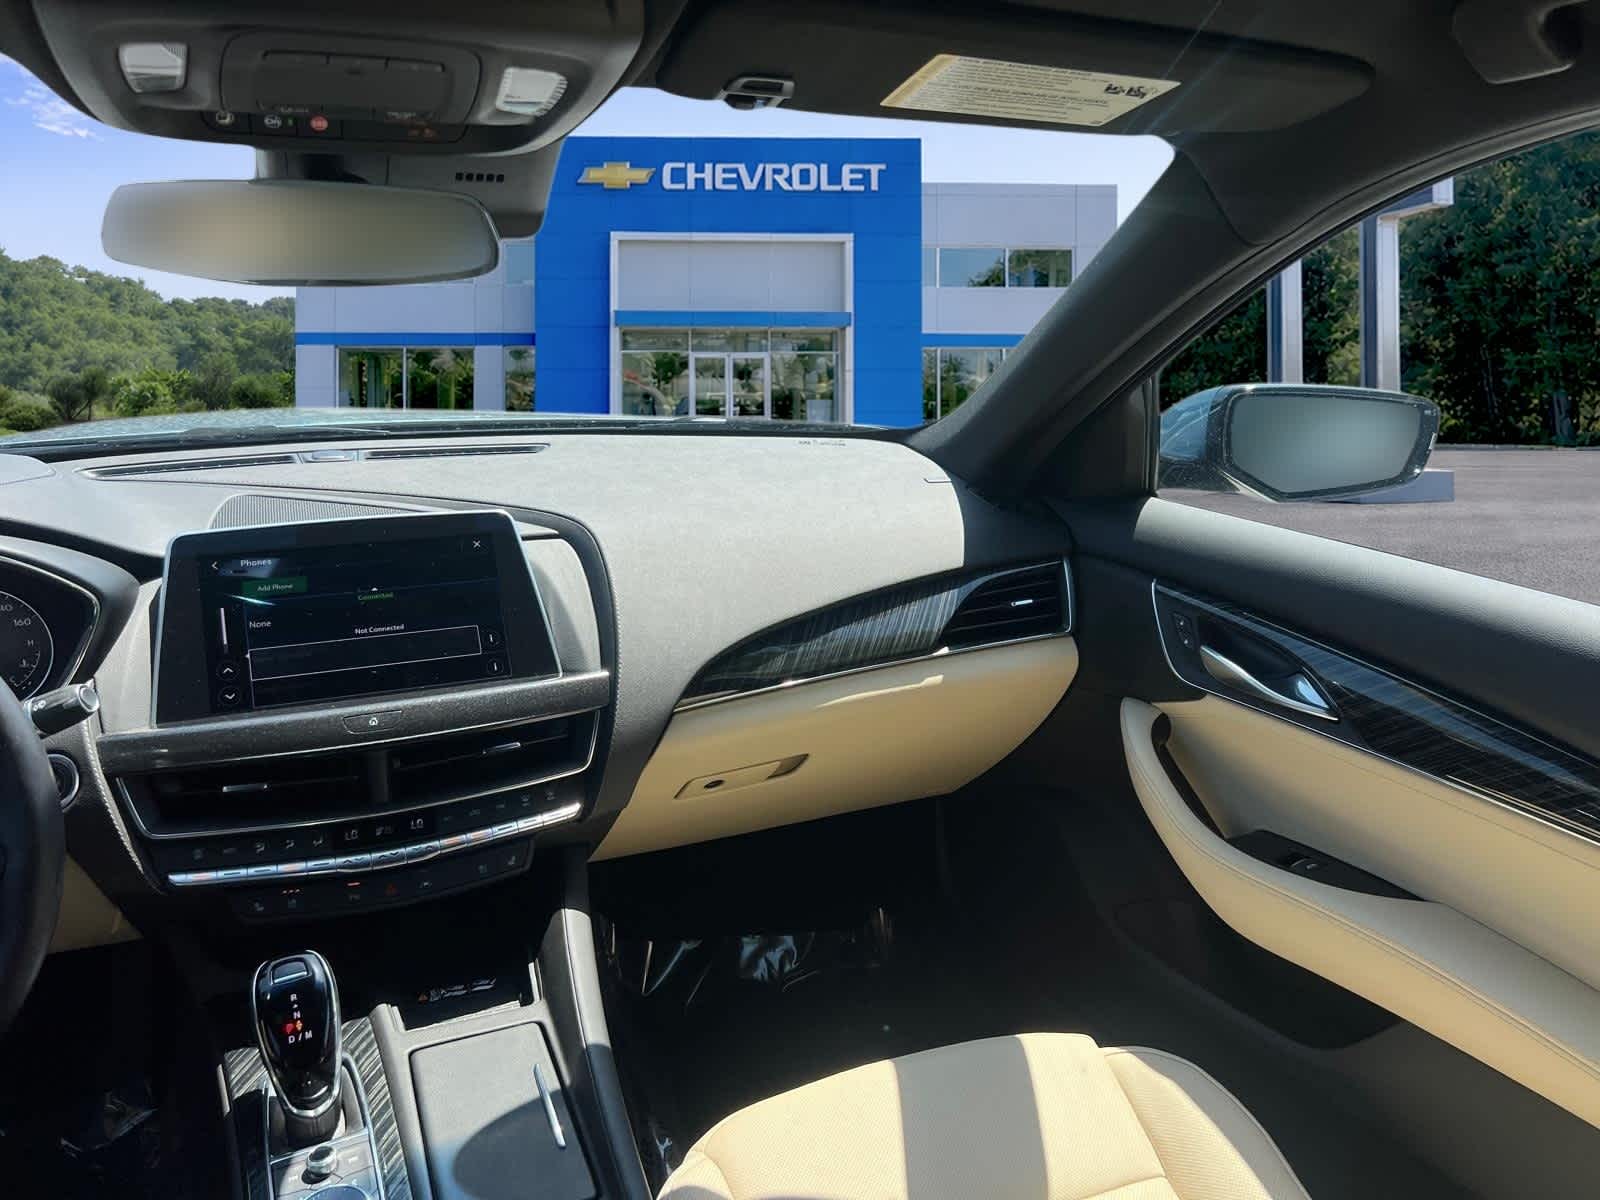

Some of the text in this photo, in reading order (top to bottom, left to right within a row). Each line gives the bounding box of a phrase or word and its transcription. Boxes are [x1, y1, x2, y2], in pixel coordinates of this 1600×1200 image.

[662, 162, 887, 192] CHEVROLET
[240, 559, 272, 567] Phones
[249, 620, 272, 629] None
